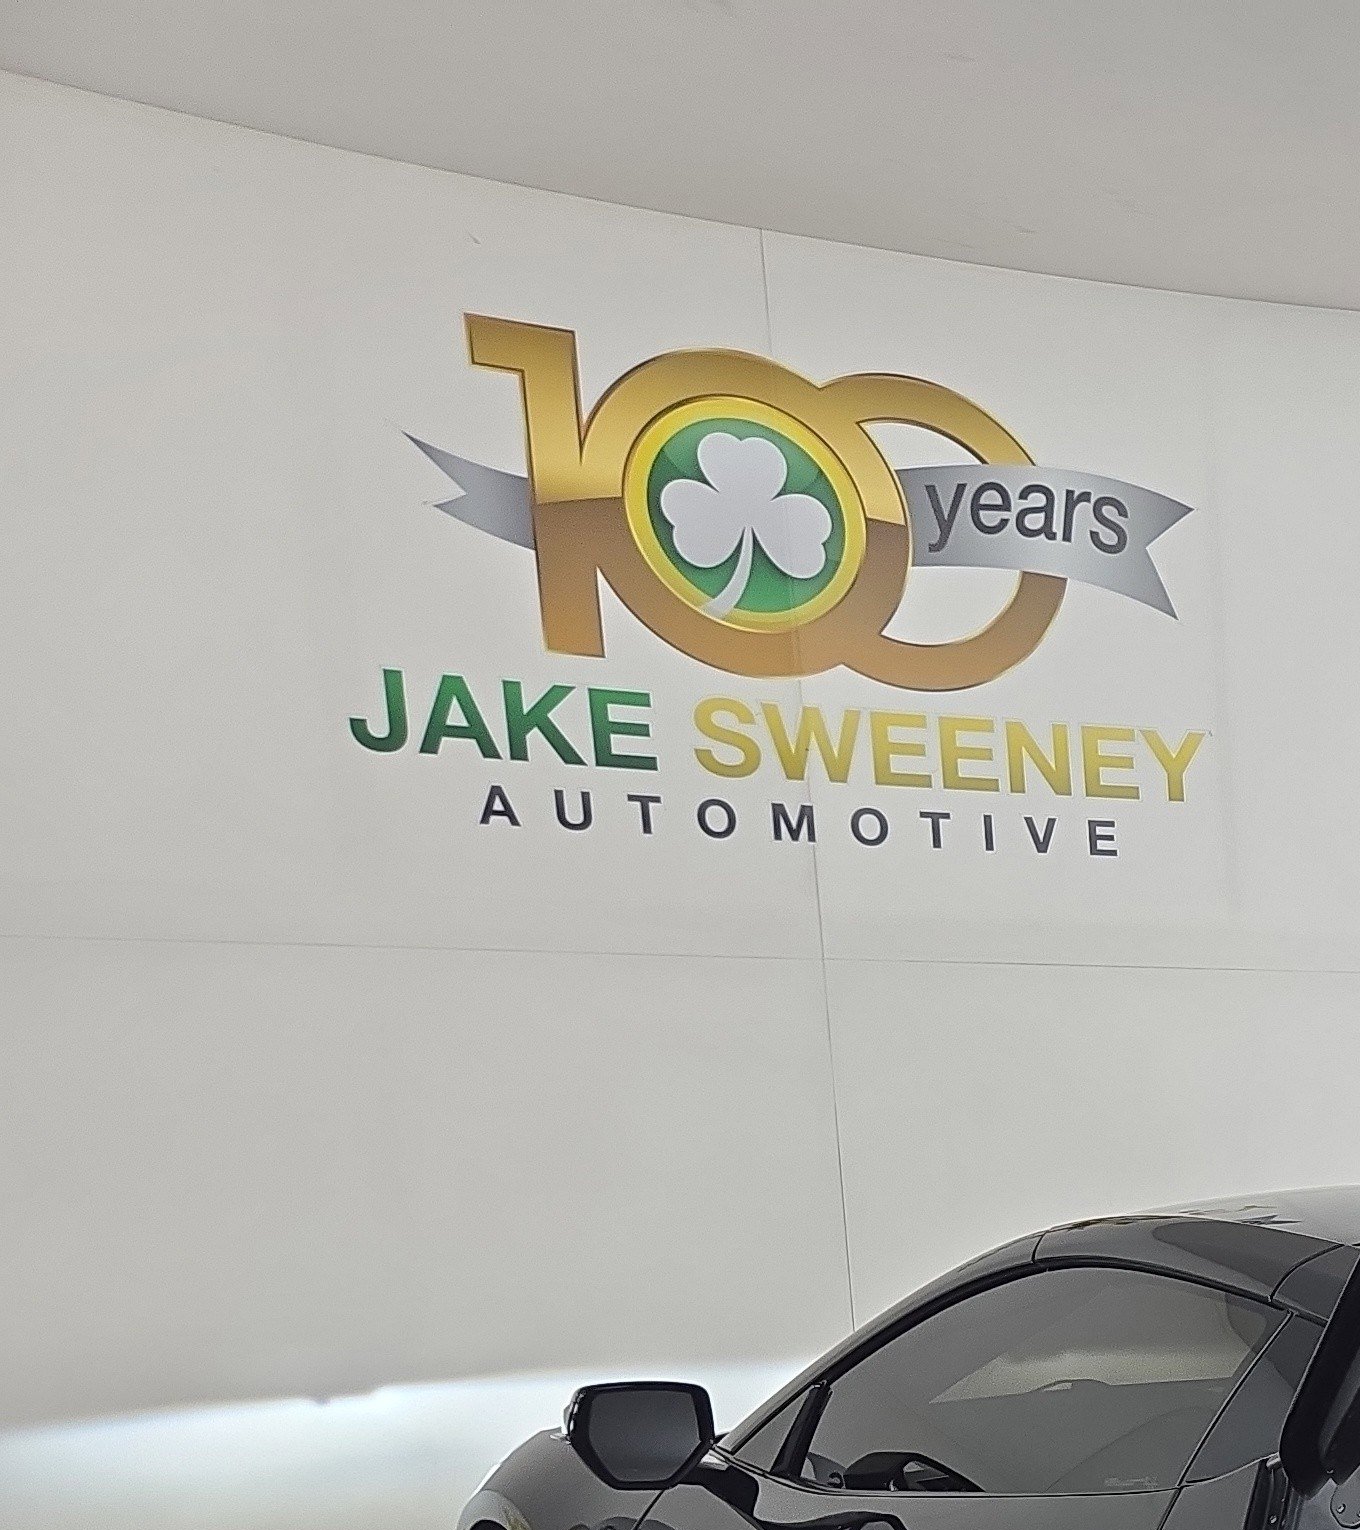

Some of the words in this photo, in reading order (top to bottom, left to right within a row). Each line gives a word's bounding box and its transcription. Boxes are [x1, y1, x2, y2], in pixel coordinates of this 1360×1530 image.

[924, 475, 1130, 557] years
[348, 667, 659, 773] JAKE
[693, 697, 1208, 803] SWEENEY
[480, 785, 1119, 858] AUTOMOTIVE
